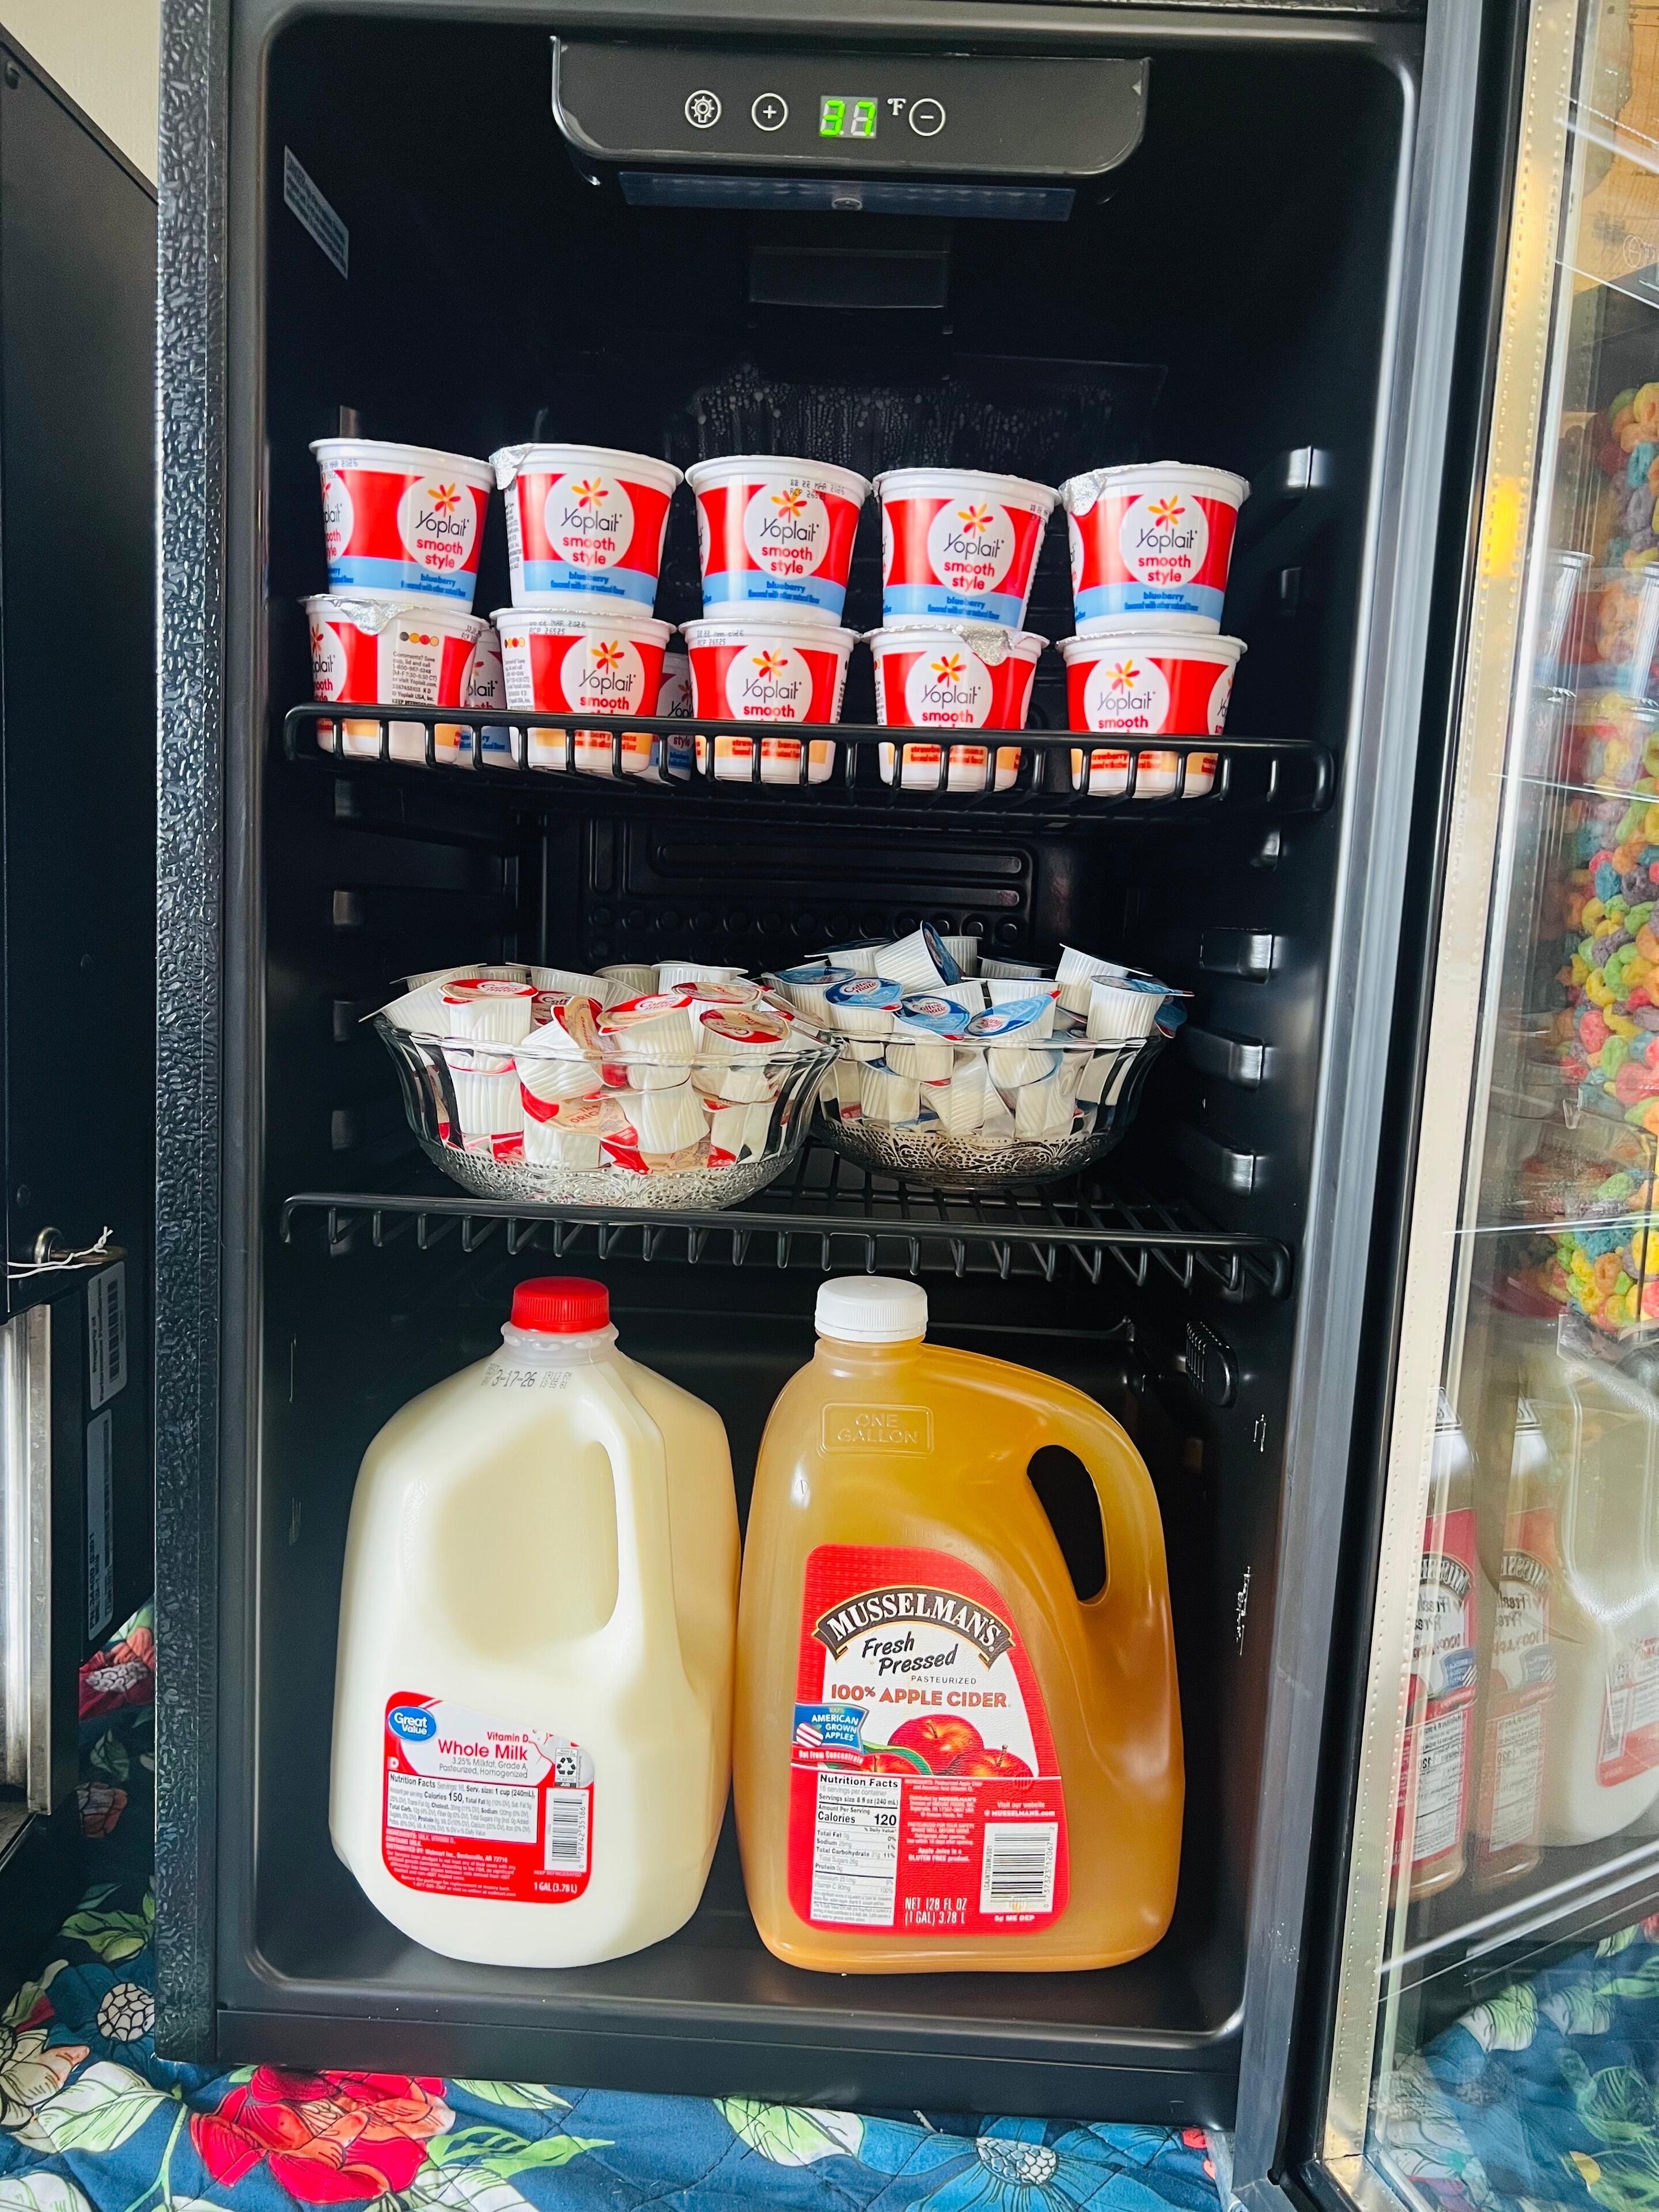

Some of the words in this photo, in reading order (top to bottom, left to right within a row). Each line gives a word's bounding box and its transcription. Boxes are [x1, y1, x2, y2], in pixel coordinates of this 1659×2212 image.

[821, 100, 875, 137] 37
[415, 510, 467, 538] Yoplait
[560, 507, 619, 534] Yoplait
[759, 517, 816, 544] Yoplait
[416, 538, 463, 556] smooth
[563, 536, 616, 551] smooth
[943, 533, 1001, 559] Yoplait
[1136, 528, 1194, 553] Yoplait
[425, 552, 455, 569] style
[573, 549, 606, 566] style
[762, 546, 813, 561] smooth
[1138, 554, 1191, 568] smooth
[771, 559, 804, 576] style
[944, 562, 995, 577] smooth
[952, 575, 984, 591] style
[1147, 569, 1181, 585] style
[579, 669, 632, 695] Yoplait
[743, 678, 797, 703] Yoplait
[921, 685, 976, 709] Yoplait
[580, 696, 629, 710] smooth
[744, 704, 795, 717] smooth
[1097, 691, 1152, 716] Yoplait
[922, 710, 973, 722] smooth
[1099, 715, 1148, 729] smooth
[843, 980, 873, 993] Coffee
[579, 1103, 599, 1114] The
[492, 1369, 537, 1387] 3-17-26
[855, 1413, 899, 1427] ONE
[838, 1428, 918, 1444] GALLON
[827, 1593, 1001, 1647] MUSSELMAN'S
[862, 1631, 914, 1658] Fresh
[879, 1643, 959, 1676] Pressed
[911, 1676, 976, 1685] PASTEURIZED
[831, 1684, 876, 1700] 100%
[880, 1688, 942, 1706] APPLE
[946, 1691, 1007, 1708] CIDER
[394, 1712, 427, 1728] Great
[812, 1714, 858, 1725] AMERICAN
[402, 1724, 427, 1735] Value
[825, 1724, 857, 1734] GROWN
[825, 1732, 854, 1741] APPLES
[487, 1732, 520, 1742] Vitamin
[522, 1734, 528, 1742] D
[438, 1739, 489, 1757] Whole
[495, 1744, 528, 1760] Milk
[440, 1764, 478, 1775] Pasteurized,
[480, 1768, 528, 1778] Homogenized
[452, 1758, 471, 1766] 3.25%
[498, 1762, 520, 1770] Grade
[390, 1774, 416, 1785] Nutrition
[418, 1778, 435, 1788] Facts
[820, 1774, 866, 1786] Nutrition
[870, 1779, 898, 1787] Facts
[424, 1791, 446, 1800] Calories
[819, 1794, 842, 1802] Servings
[818, 1811, 855, 1823] Calories
[874, 1813, 896, 1825] 120
[832, 1849, 870, 1857] Carbohydrate
[1046, 1842, 1054, 1869] 12067
[534, 1882, 537, 1891] 1
[539, 1883, 552, 1891] GAL
[553, 1883, 570, 1893] (3.78
[571, 1884, 577, 1893] L)
[1044, 1869, 1053, 1894] 37323
[905, 1897, 921, 1910] NET
[926, 1897, 940, 1910] 128
[944, 1897, 952, 1910] FL
[956, 1897, 967, 1910] OZ
[905, 1911, 912, 1926] (1
[916, 1911, 935, 1926] GAL)
[939, 1911, 957, 1924] 3.78
[961, 1911, 965, 1924] L
